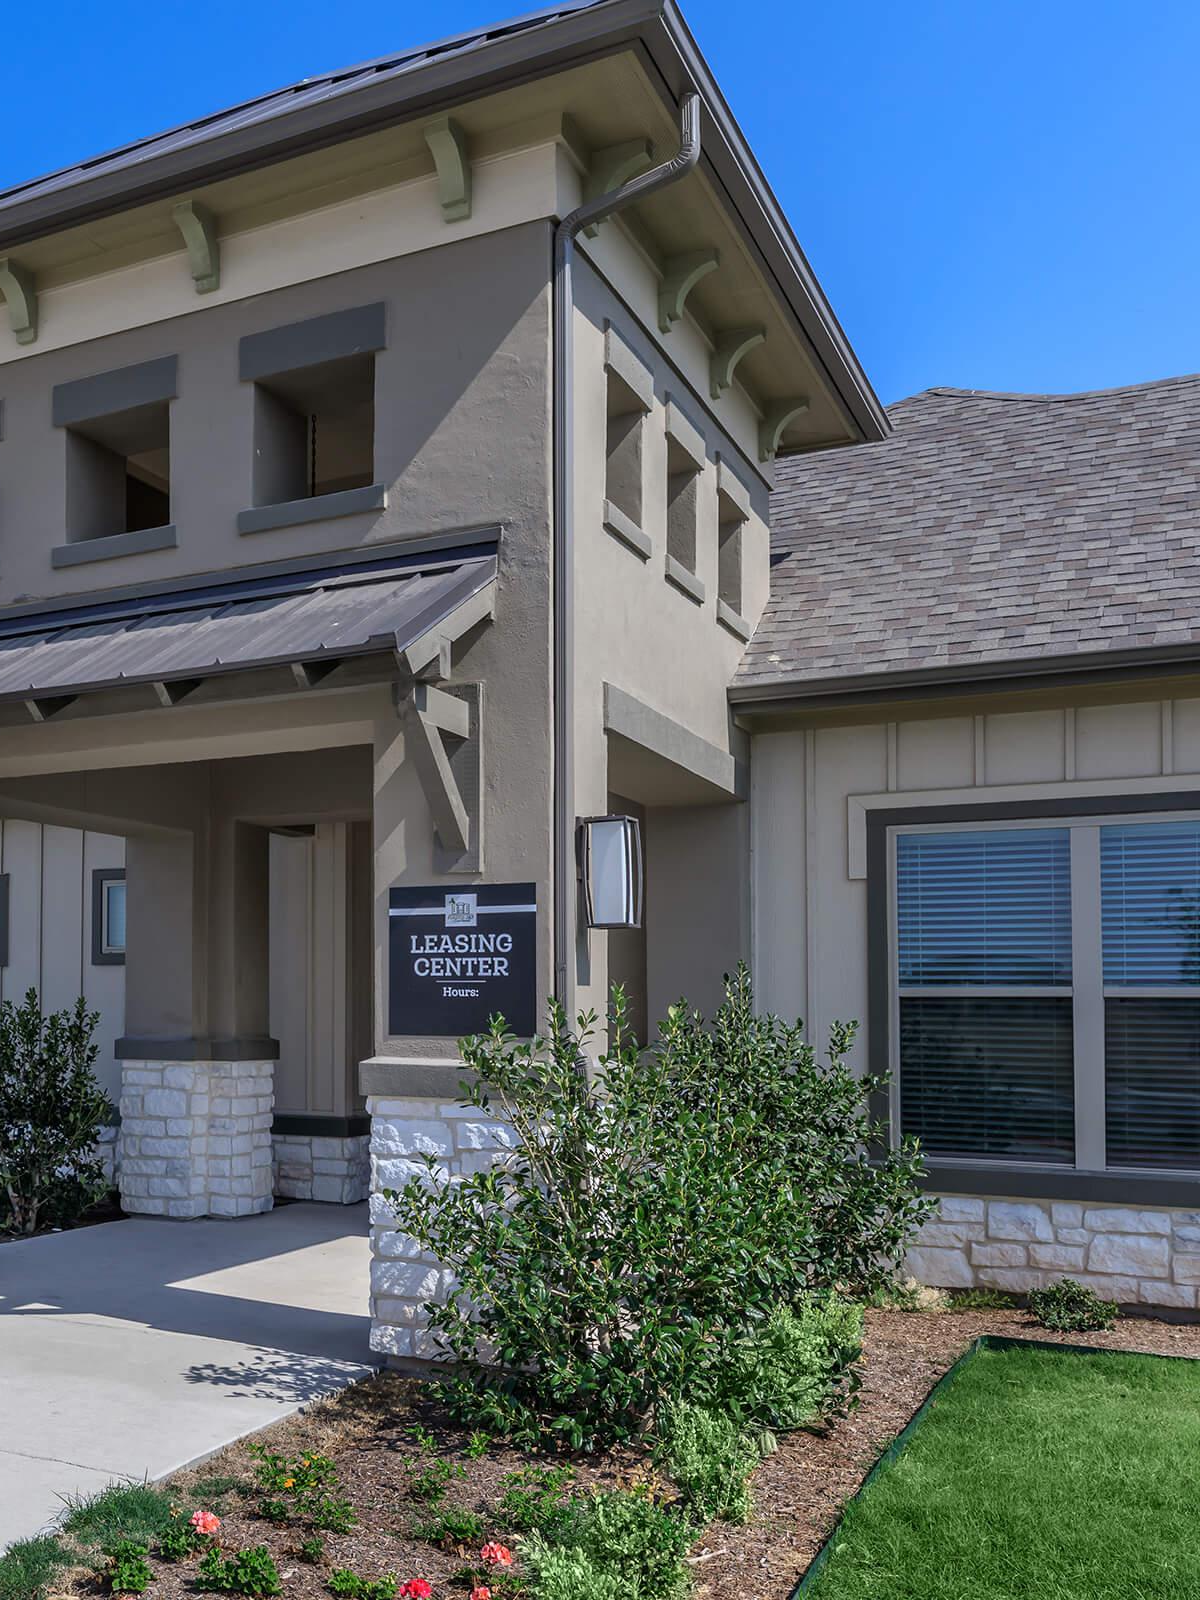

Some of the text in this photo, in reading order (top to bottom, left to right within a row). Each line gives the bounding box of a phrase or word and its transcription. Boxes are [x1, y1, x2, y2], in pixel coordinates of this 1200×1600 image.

[410, 934, 513, 954] LEASING
[414, 957, 509, 977] CENTER
[443, 987, 479, 998] Hours:
